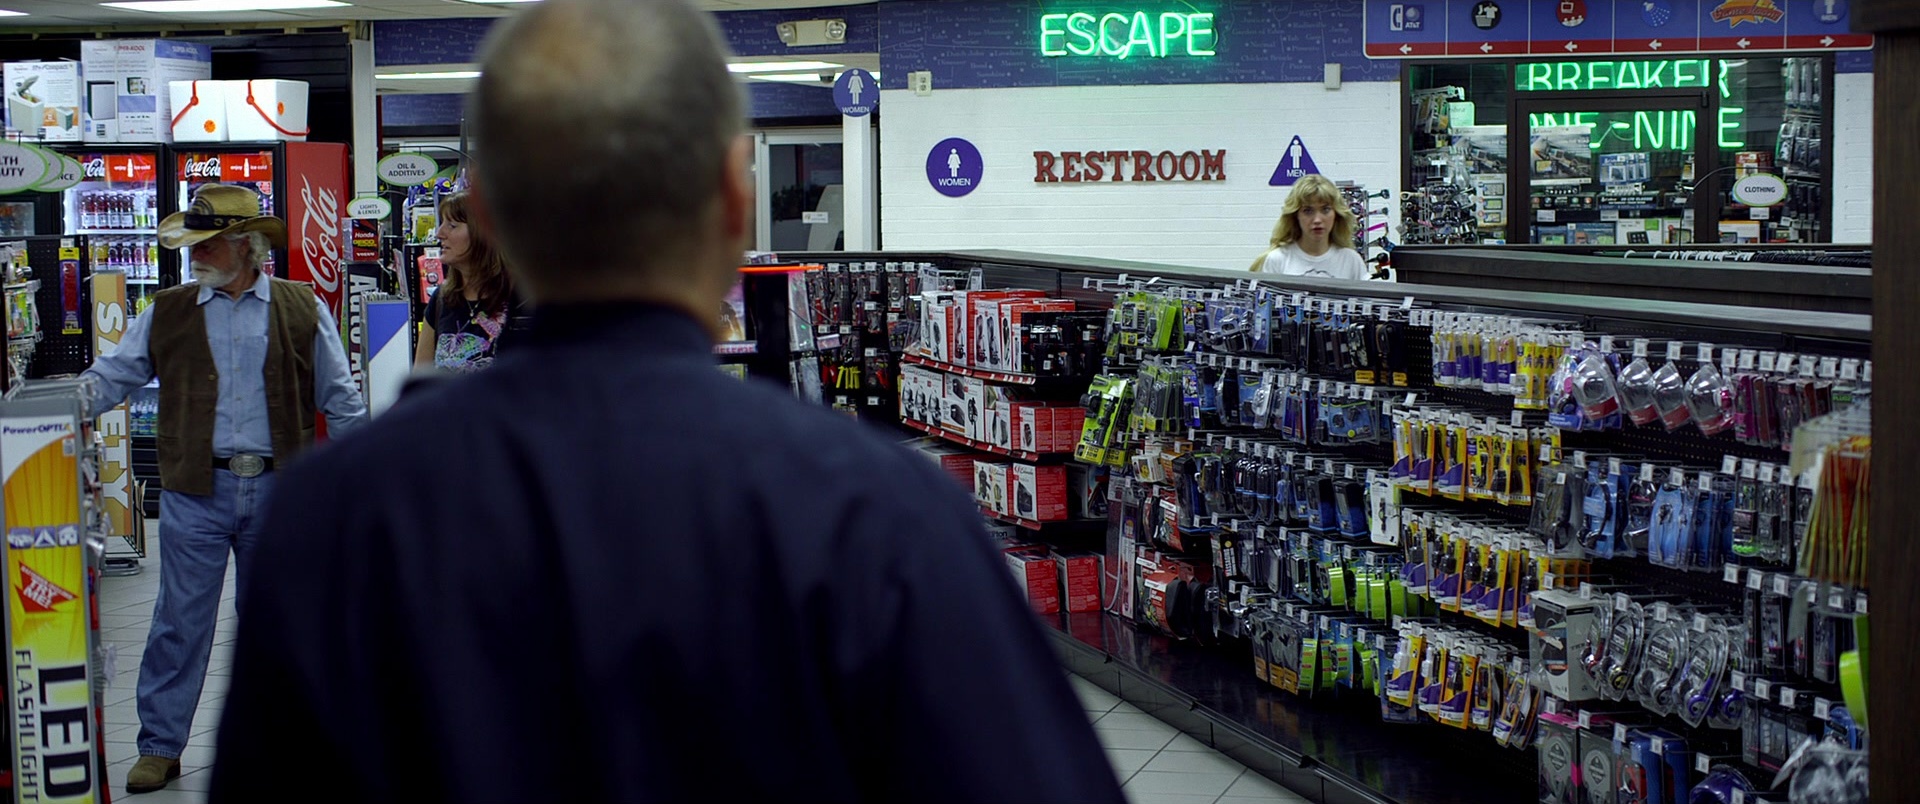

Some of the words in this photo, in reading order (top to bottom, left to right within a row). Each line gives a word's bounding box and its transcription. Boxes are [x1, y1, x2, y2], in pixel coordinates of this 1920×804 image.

[1041, 11, 1216, 60] ESCAPE
[938, 178, 971, 186] WOMEN
[1033, 150, 1226, 182] RESTROOM
[1286, 169, 1306, 177] MEN
[97, 302, 129, 510] SETY
[23, 586, 52, 609] ME!
[31, 577, 58, 598] TRY
[15, 649, 39, 803] FLASHLIGHT
[38, 664, 91, 798] LED
